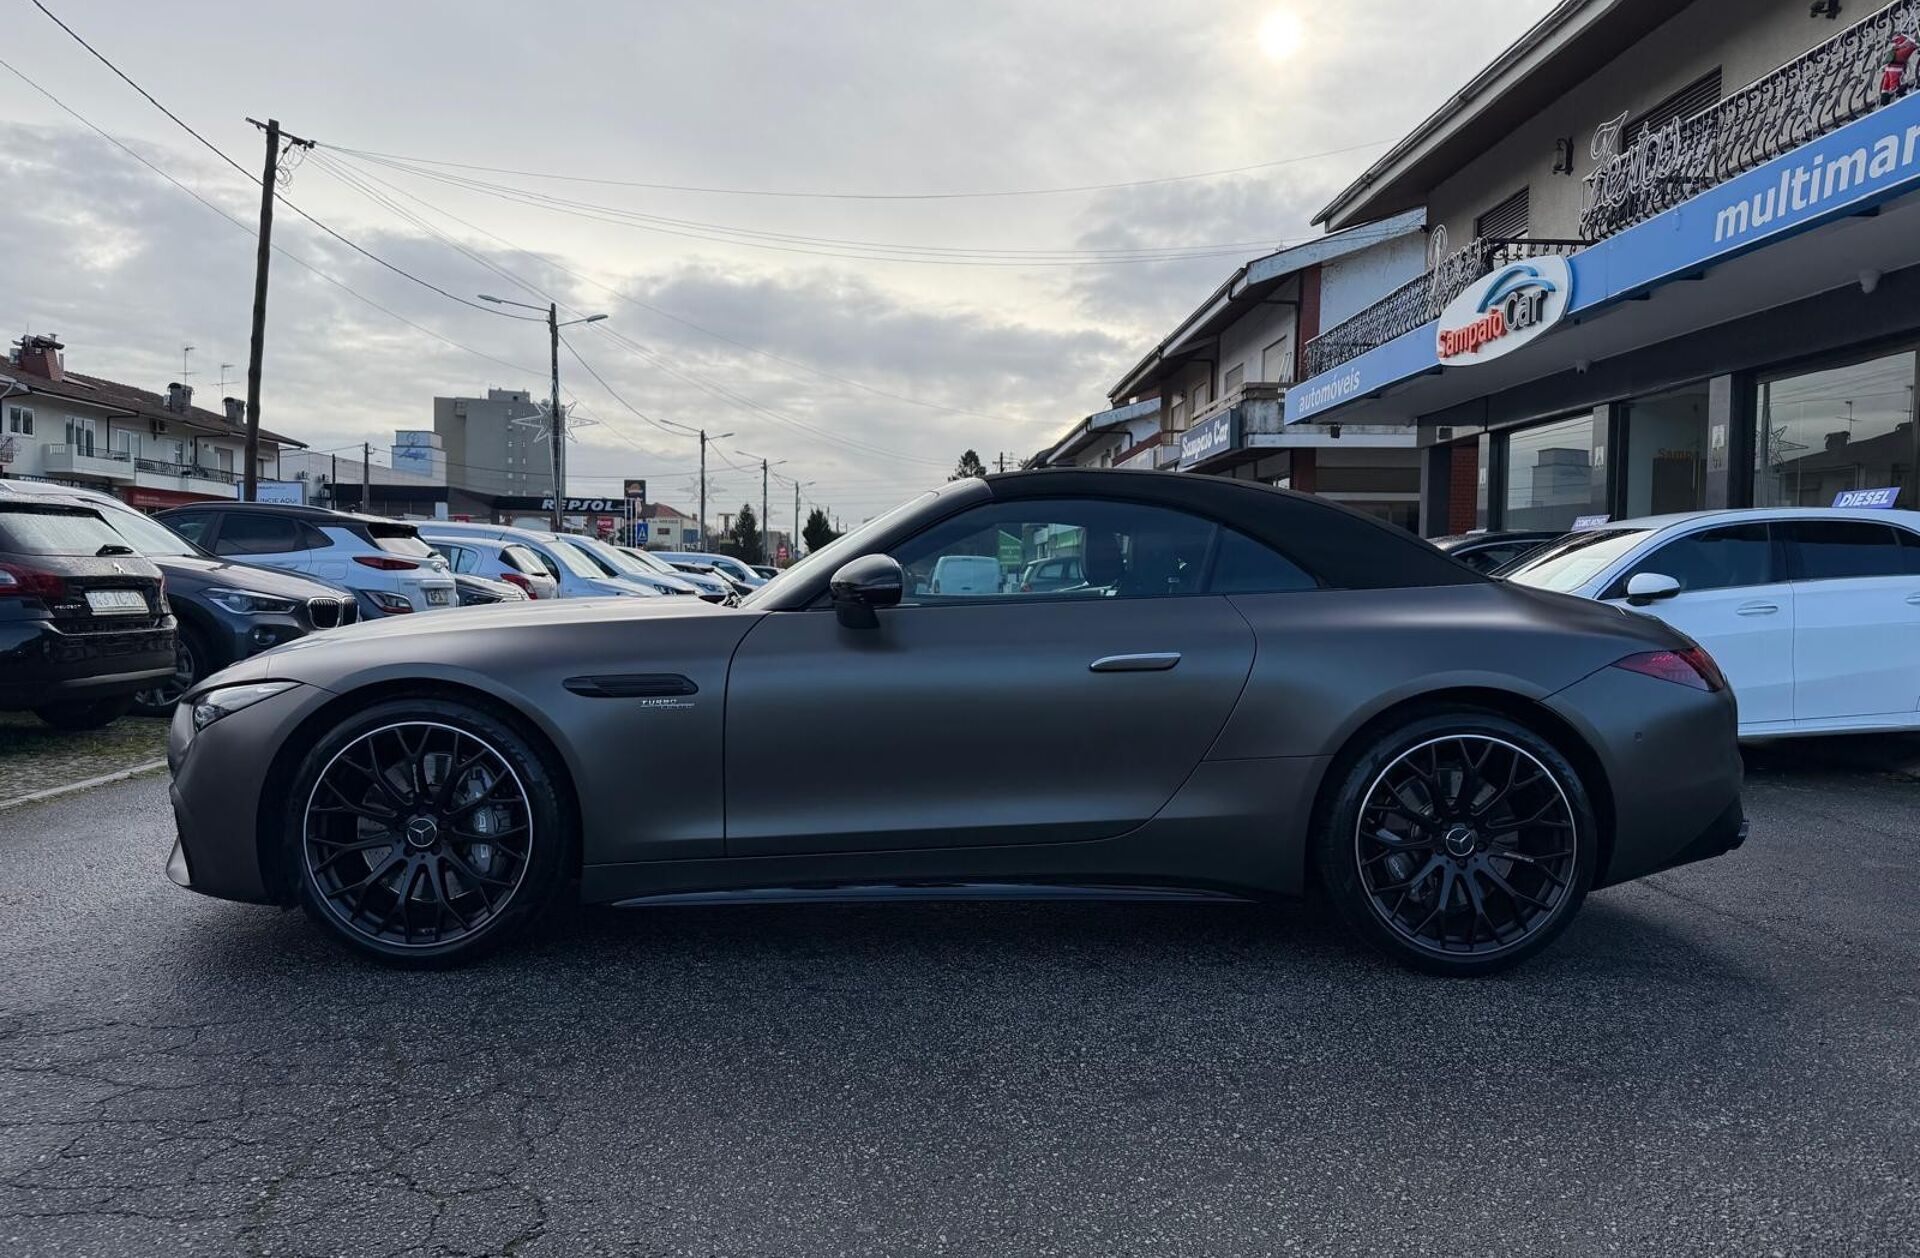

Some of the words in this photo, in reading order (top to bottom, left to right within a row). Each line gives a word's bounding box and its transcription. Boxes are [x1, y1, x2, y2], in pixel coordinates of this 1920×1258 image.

[1503, 288, 1548, 332] Car
[1299, 367, 1361, 413] automóveis
[1181, 427, 1212, 460] Sampaio
[1213, 419, 1229, 446] Car
[541, 499, 613, 510] REPSOL
[1839, 490, 1890, 507] DIESEL
